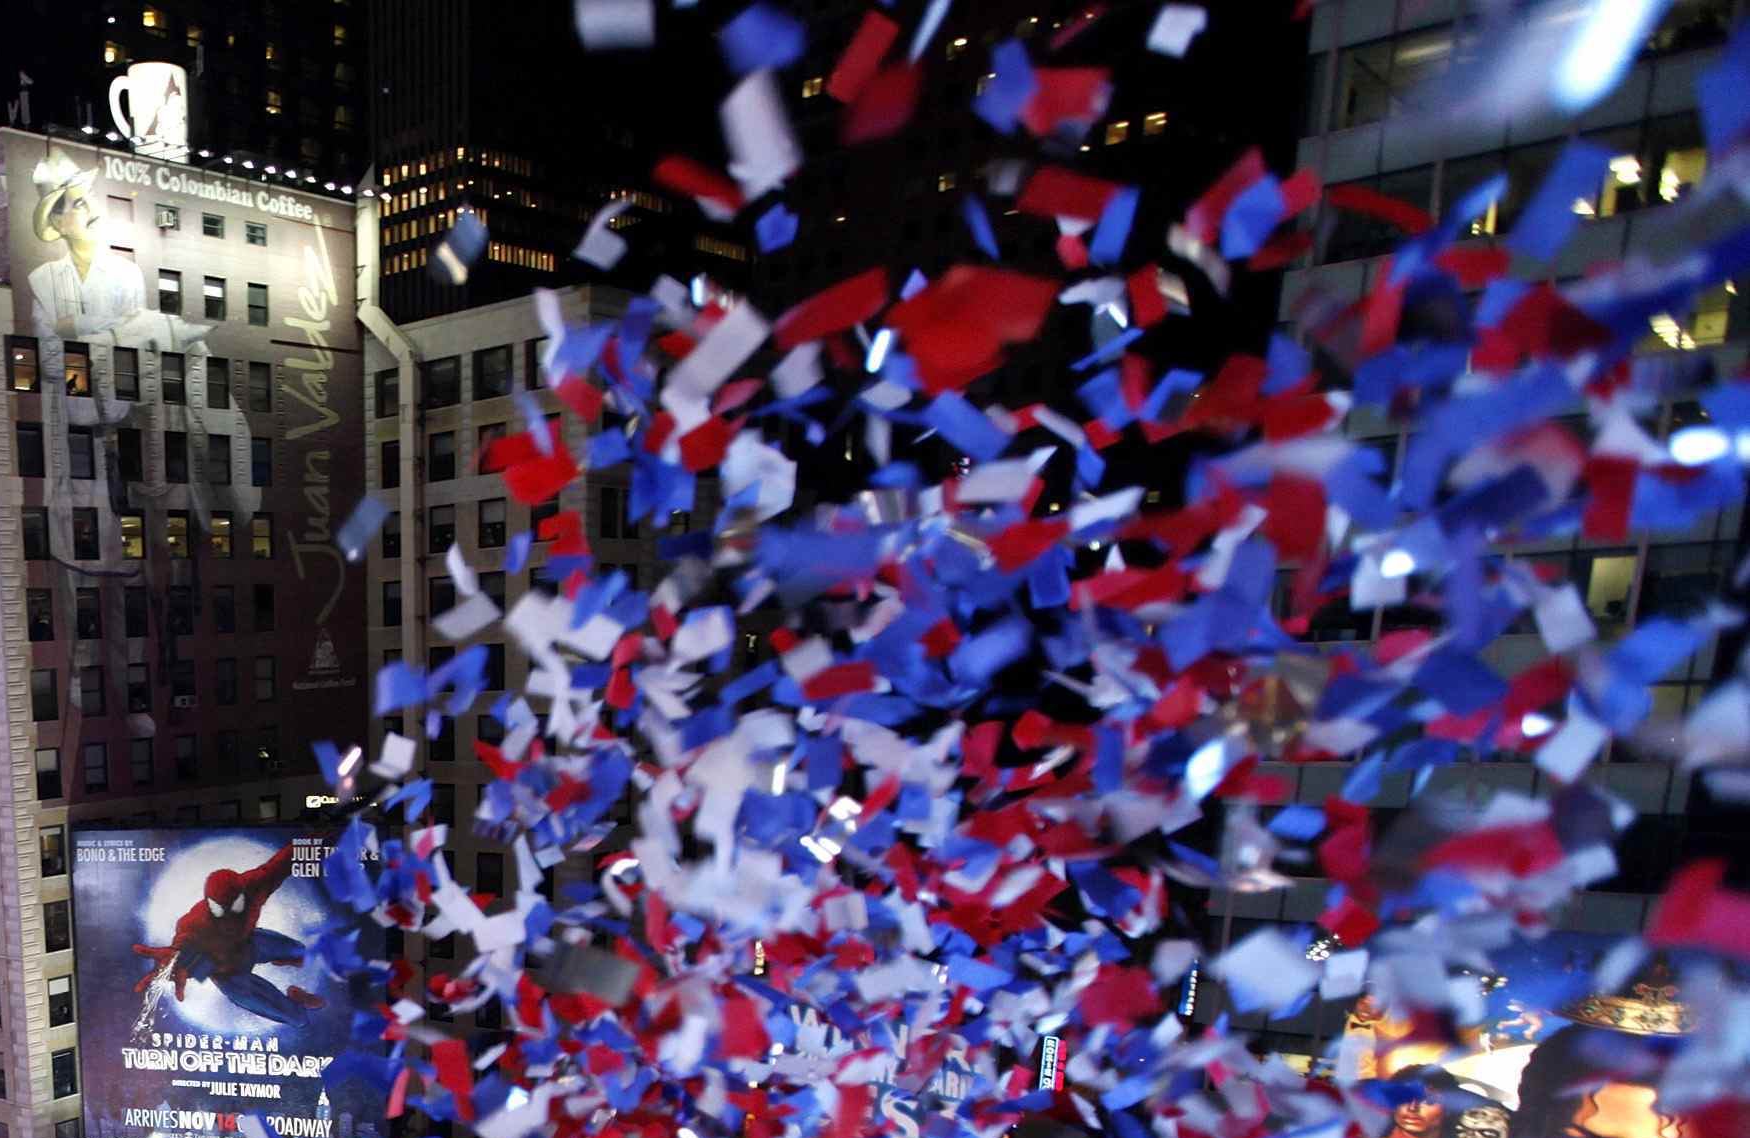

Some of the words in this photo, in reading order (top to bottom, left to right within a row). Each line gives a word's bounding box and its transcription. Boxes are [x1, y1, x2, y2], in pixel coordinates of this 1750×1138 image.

[103, 156, 151, 186] 100%
[155, 167, 254, 208] Colombian
[256, 190, 315, 220] Coffee
[283, 215, 341, 440] Valdez
[286, 449, 346, 625] Juan
[77, 848, 105, 862] BONO
[107, 849, 116, 862] &
[118, 848, 137, 862] THE
[139, 849, 166, 863] EDGE
[291, 846, 322, 861] JULIE
[291, 862, 320, 878] GLEN
[151, 1033, 279, 1052] SPIDER-MAN
[122, 1048, 179, 1071] TURN
[179, 1050, 224, 1073] OFF
[224, 1052, 267, 1075] THE
[267, 1055, 334, 1079] DARK
[209, 1082, 238, 1097] JULIE
[239, 1083, 282, 1099] TAYMOR
[123, 1108, 179, 1128] ARRIVES
[179, 1110, 217, 1131] NOV
[265, 1115, 333, 1138] OADWAY
